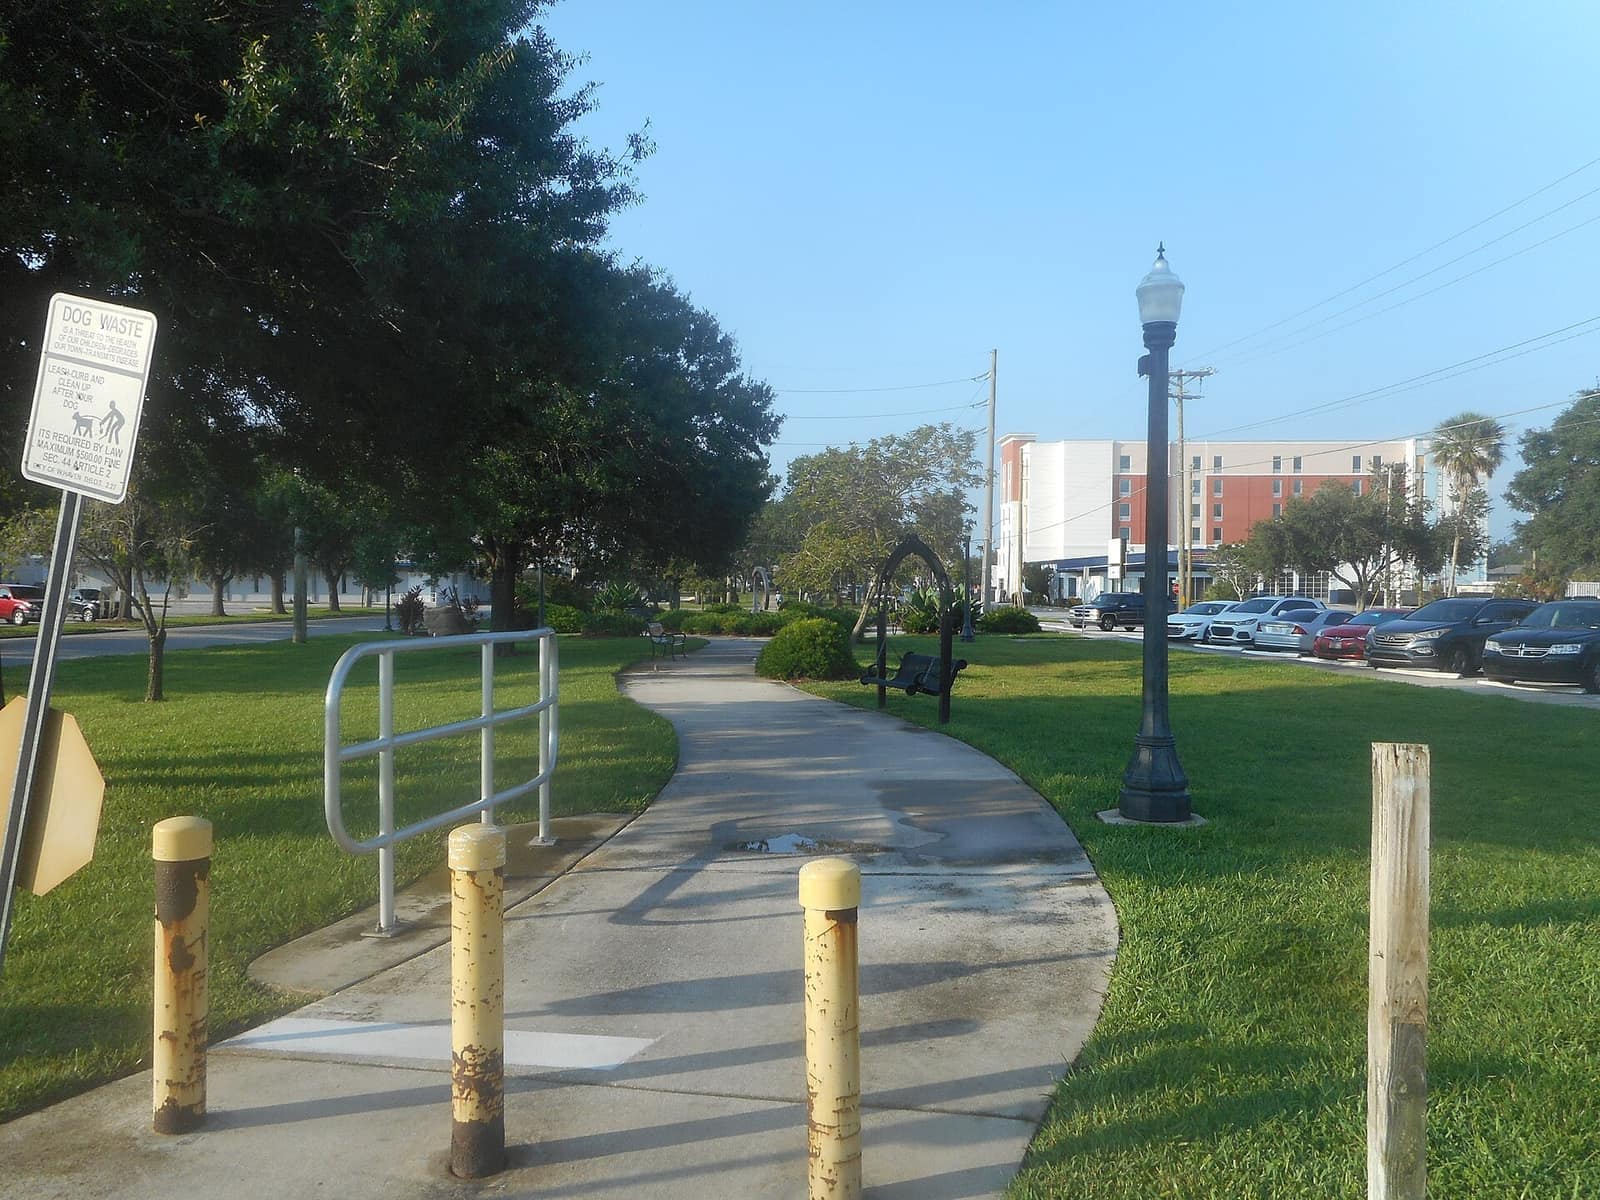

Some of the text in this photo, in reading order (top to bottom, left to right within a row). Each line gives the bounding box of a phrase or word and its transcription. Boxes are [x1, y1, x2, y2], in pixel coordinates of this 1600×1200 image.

[63, 306, 144, 338] DOG WASTE
[75, 328, 95, 339] THREAT
[96, 333, 104, 341] TO
[58, 377, 91, 392] CLEAN UP
[91, 375, 105, 385] AND
[53, 387, 94, 403] AFTER YOUR
[63, 400, 79, 410] DOG
[39, 428, 123, 458] ITS REQUIRED BY LAW
[37, 440, 75, 456] MAXIMUM
[104, 458, 121, 469] FINE
[74, 461, 105, 476] ARTICLE
[106, 470, 112, 478] 2
